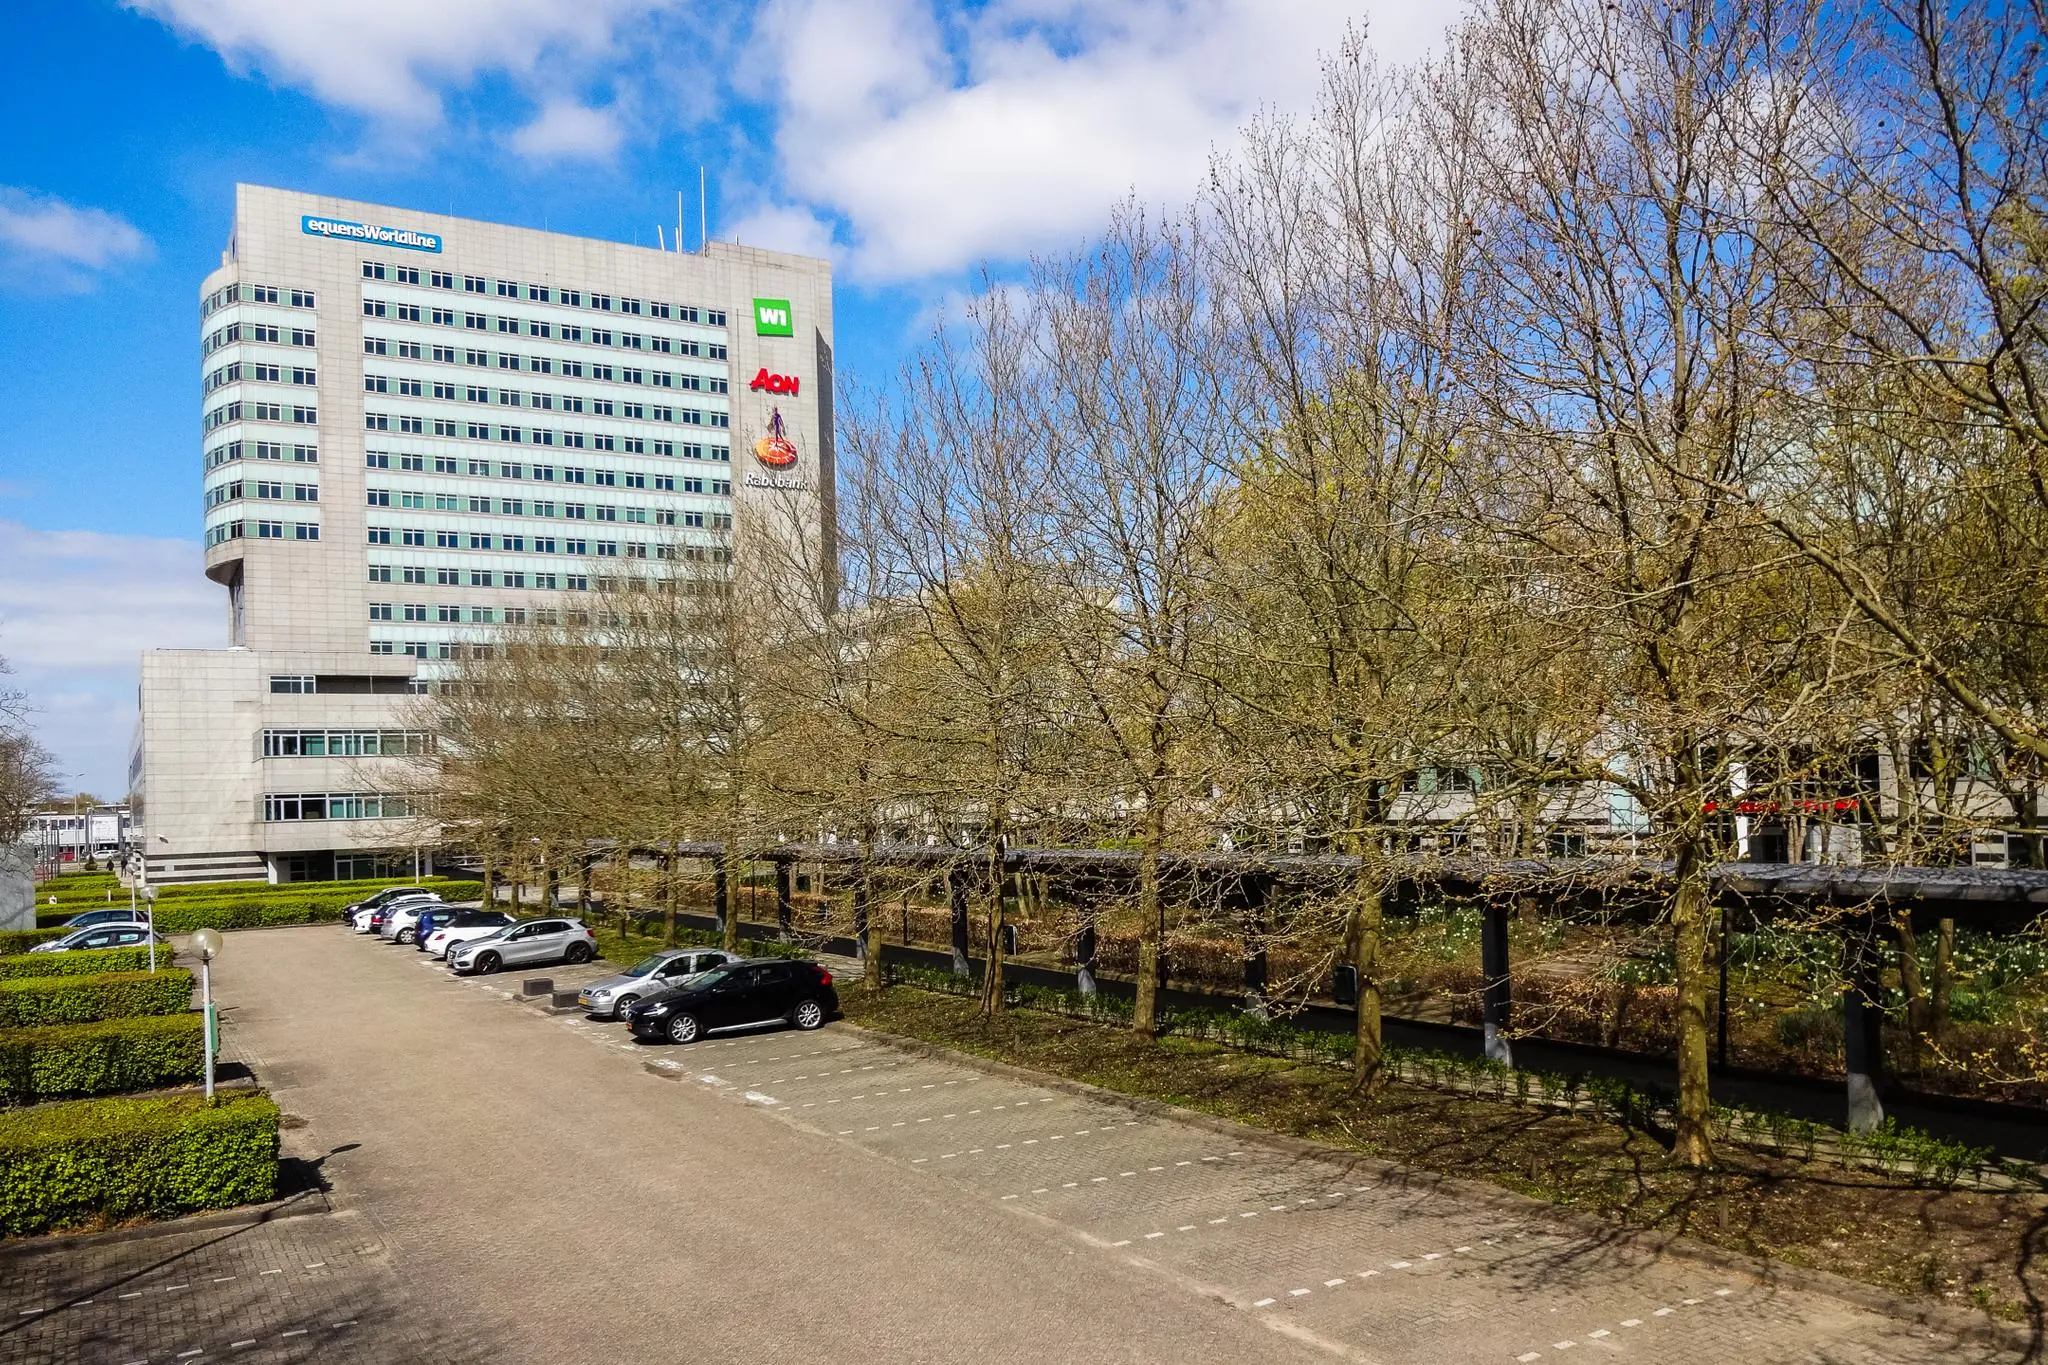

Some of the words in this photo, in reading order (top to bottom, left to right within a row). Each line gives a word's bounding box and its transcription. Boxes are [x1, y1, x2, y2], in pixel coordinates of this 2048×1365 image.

[307, 219, 437, 249] equensWorldline
[759, 306, 787, 327] W1
[750, 367, 799, 396] AON
